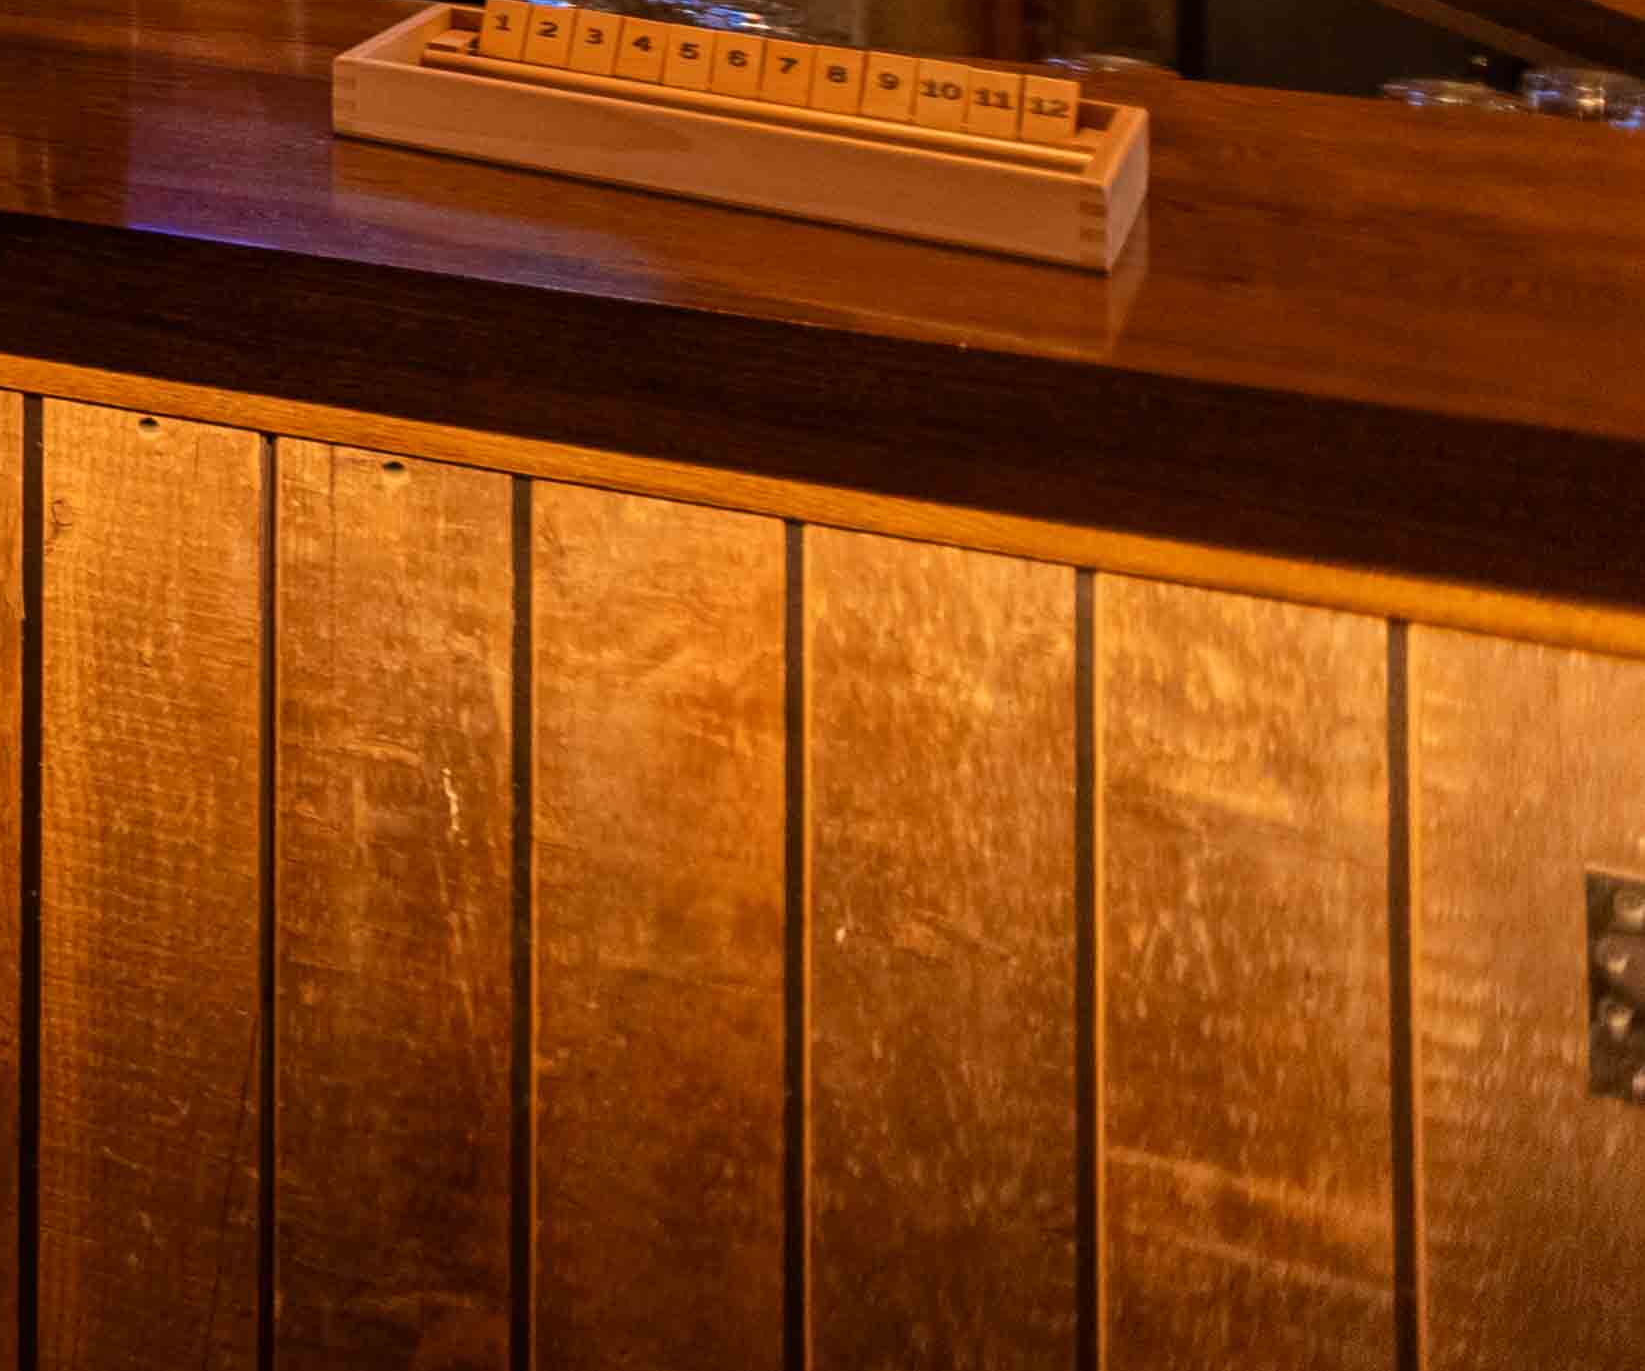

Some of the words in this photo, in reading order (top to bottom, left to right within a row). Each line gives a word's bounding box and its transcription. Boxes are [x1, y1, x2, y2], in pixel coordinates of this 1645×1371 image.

[494, 14, 511, 32] 1
[537, 21, 559, 39] 2
[586, 28, 604, 45] 3
[632, 35, 652, 52] 4
[679, 42, 700, 60] 5
[727, 49, 748, 68] 6
[776, 56, 798, 74] 7
[826, 65, 848, 84] 8
[877, 73, 900, 91] 9
[920, 78, 963, 101] 10
[973, 88, 1013, 110] 11
[1028, 96, 1071, 119] 12
